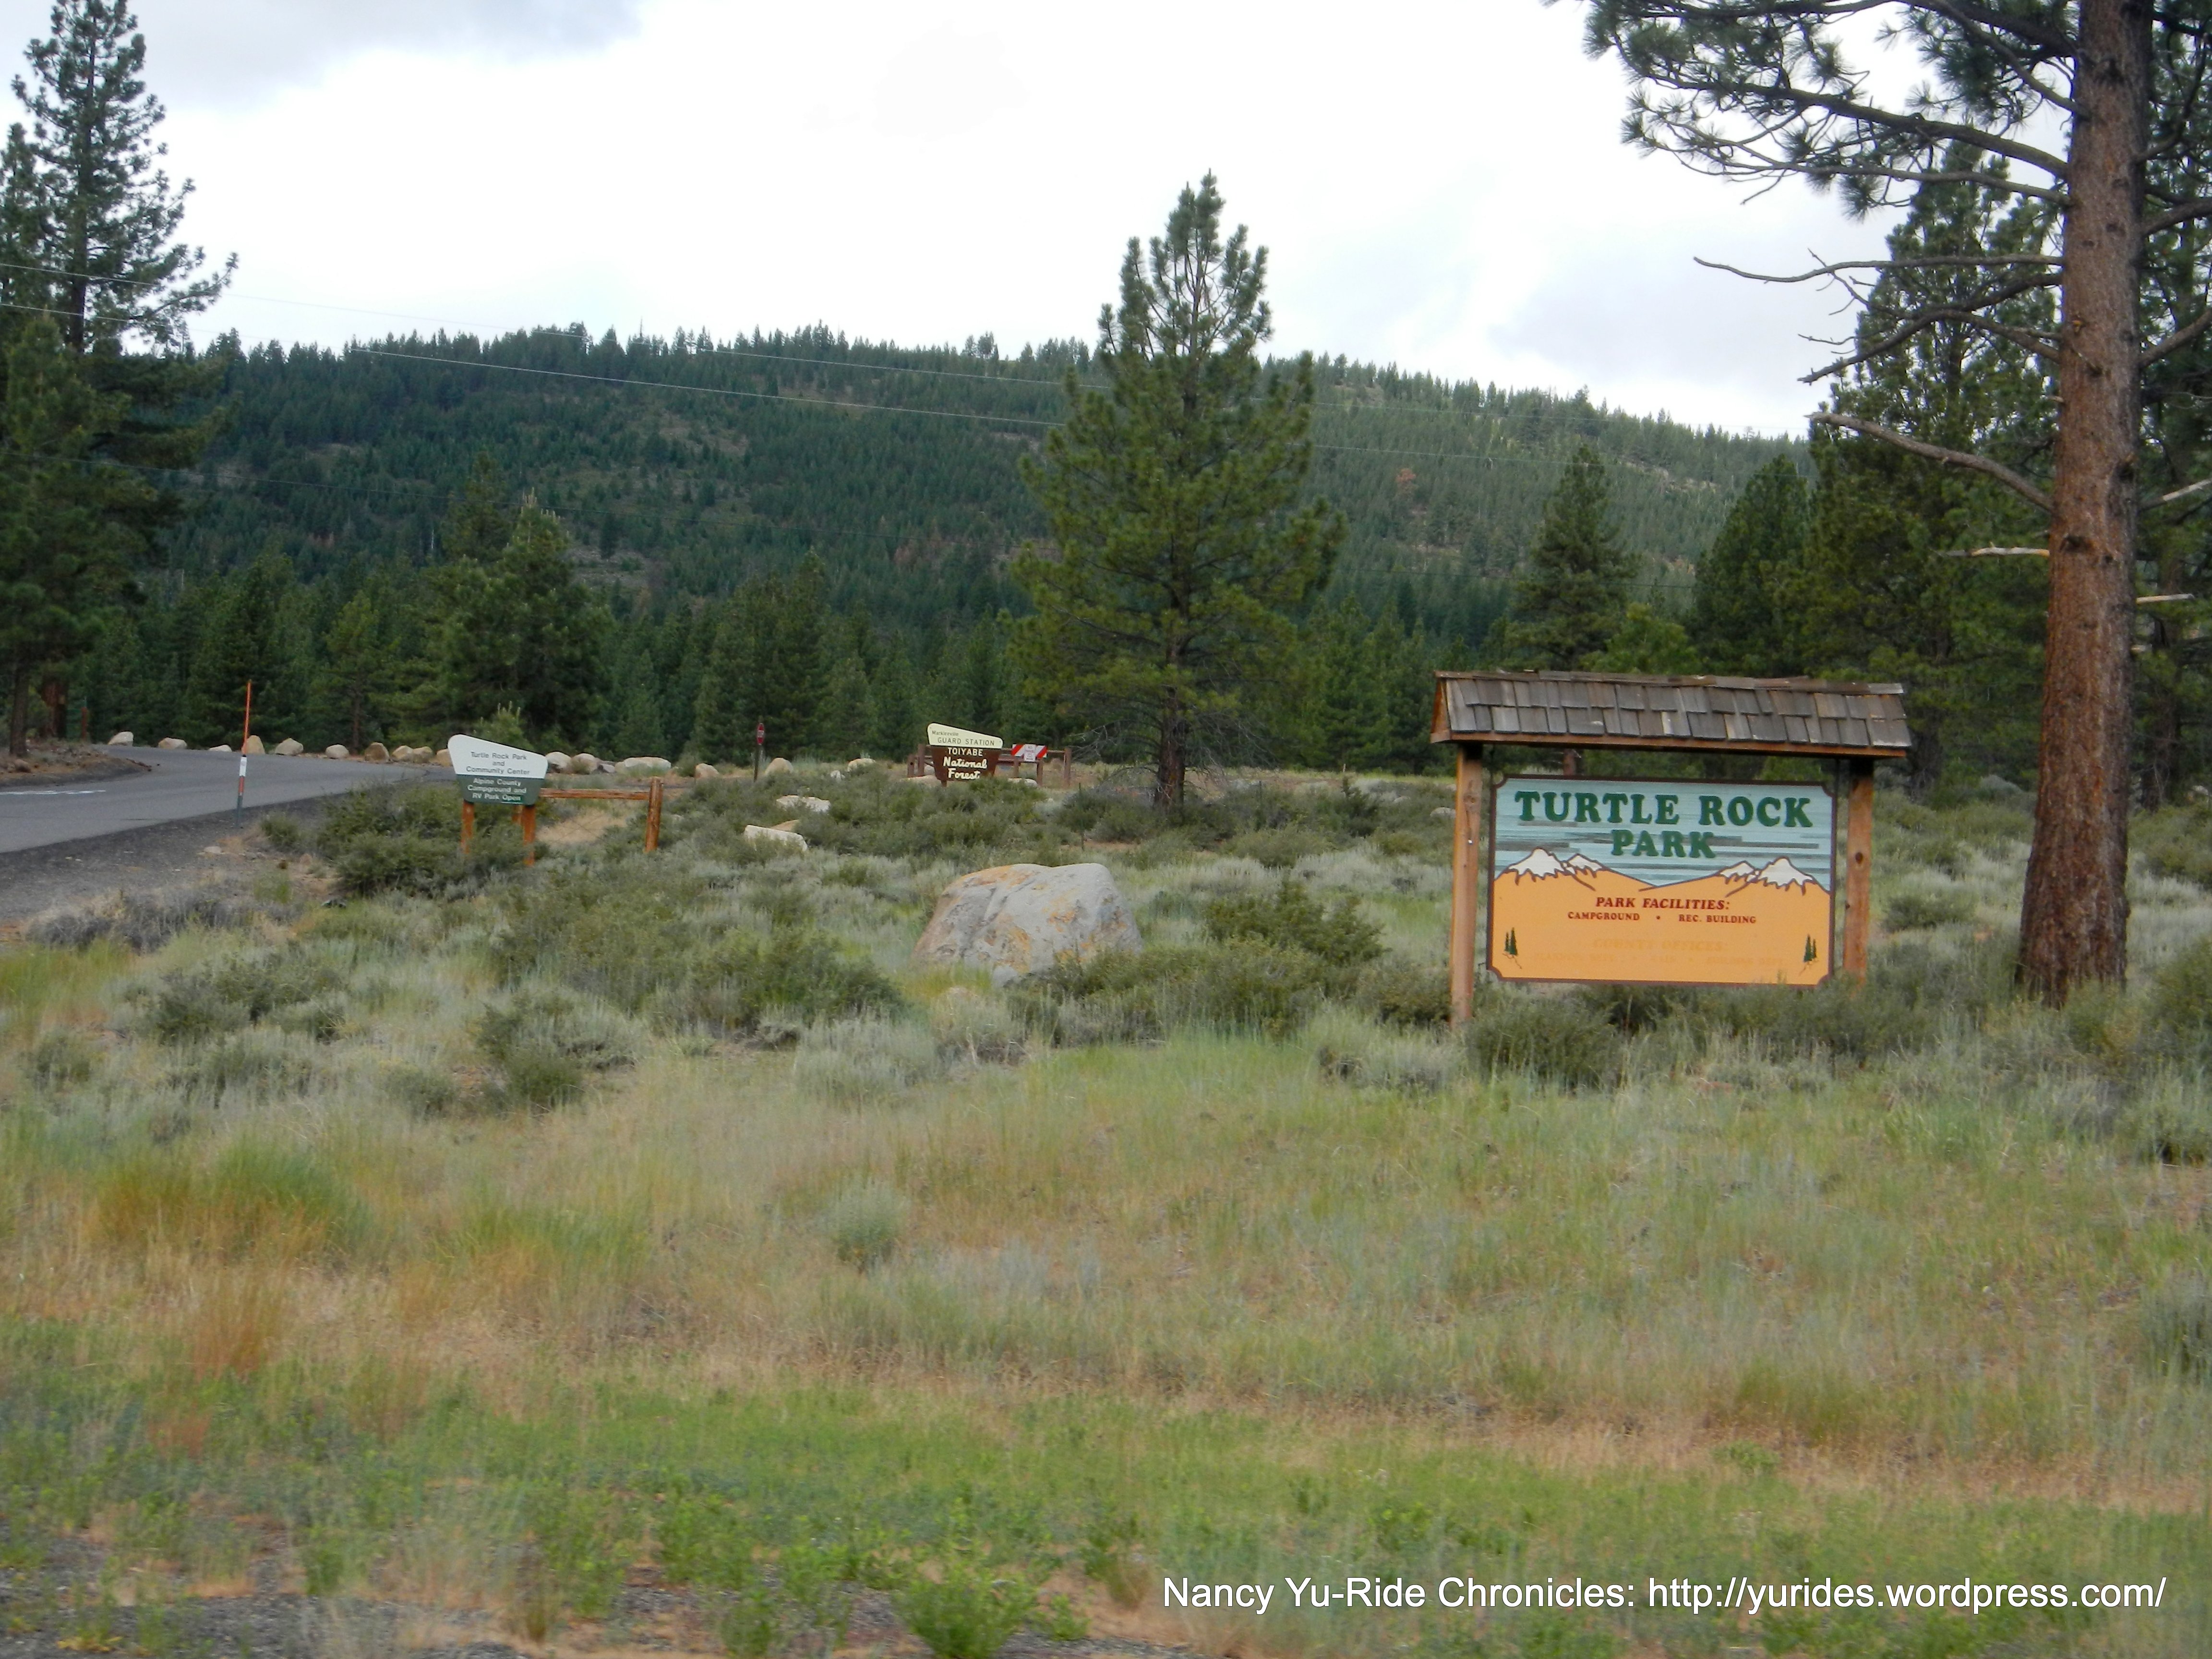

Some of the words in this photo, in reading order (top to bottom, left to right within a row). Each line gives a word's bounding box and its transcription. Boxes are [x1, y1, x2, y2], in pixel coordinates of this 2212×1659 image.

[947, 747, 984, 757] TOIYABE
[943, 756, 987, 769] National
[466, 766, 504, 774] Community
[948, 768, 981, 780] Forest
[467, 784, 511, 793] Campground
[473, 778, 494, 786] Alpine
[496, 779, 522, 787] County
[1514, 791, 1681, 825] TURTLE
[1698, 795, 1814, 828] ROCK
[1611, 829, 1717, 859] PARK
[1595, 897, 1636, 908] PARK
[1642, 898, 1731, 910] FACILITIES:
[1567, 912, 1640, 921] CAMPGROUND
[1678, 914, 1702, 922] REC.
[1706, 915, 1757, 924] BUILDING
